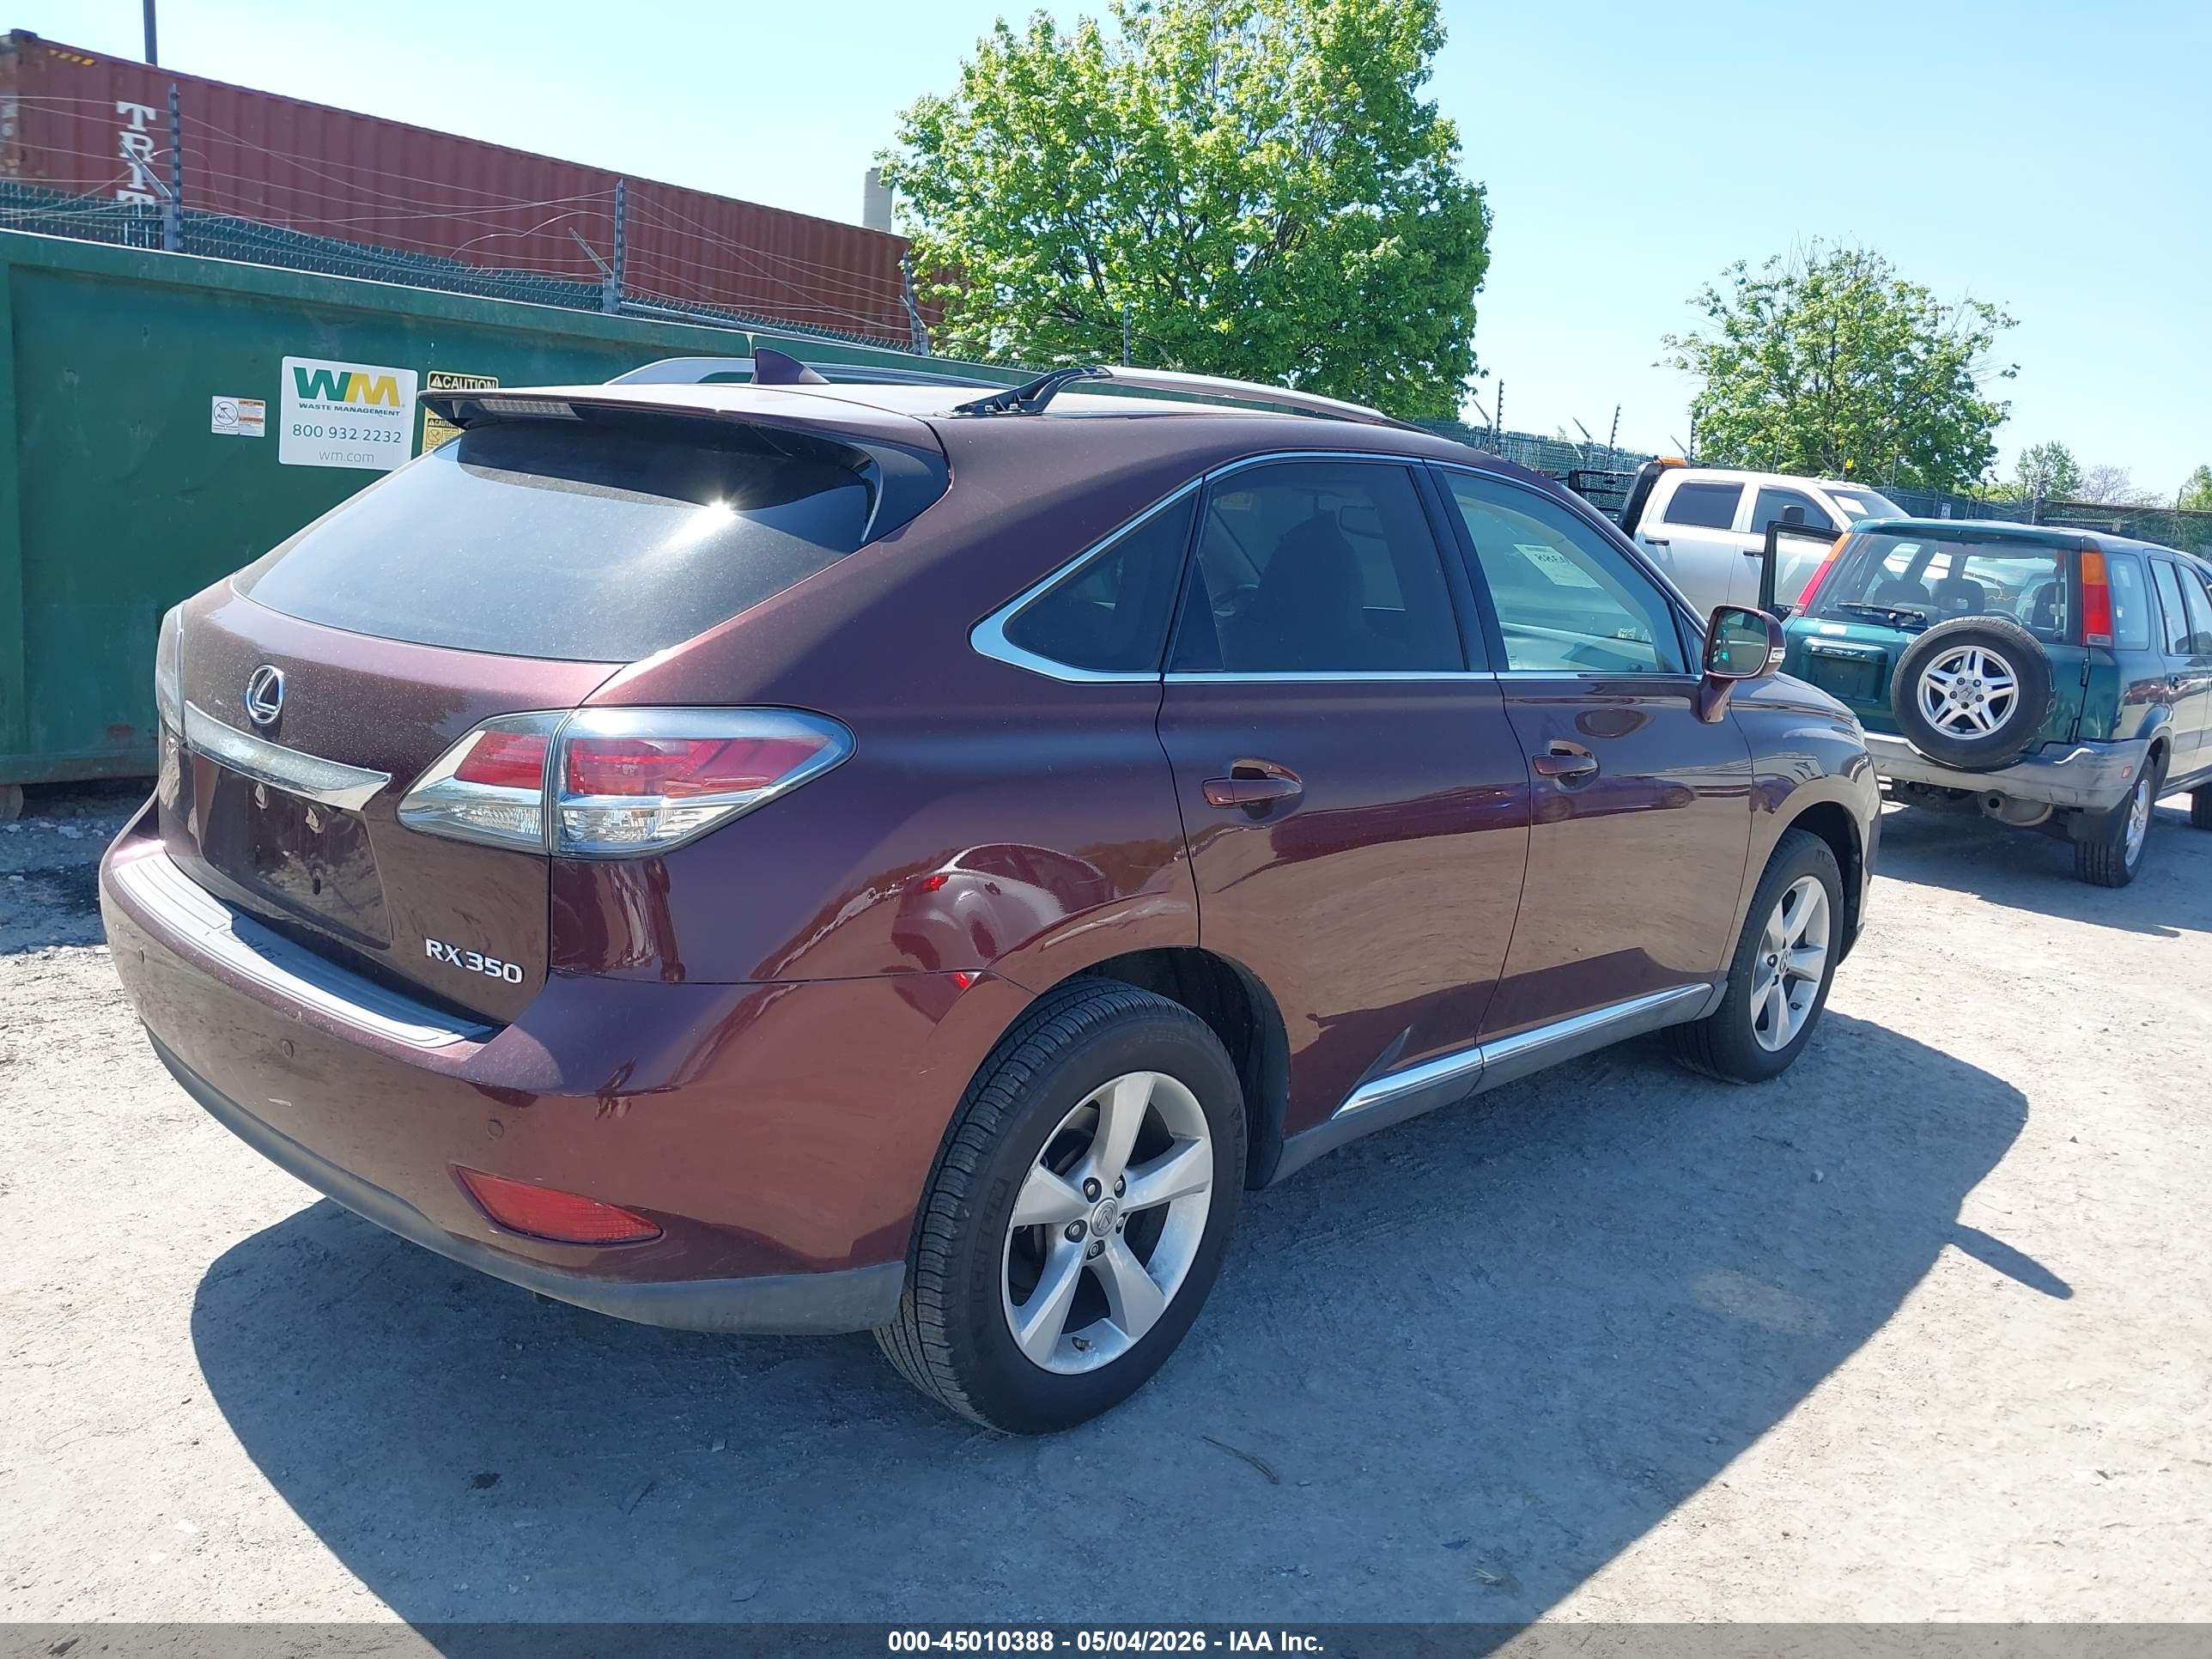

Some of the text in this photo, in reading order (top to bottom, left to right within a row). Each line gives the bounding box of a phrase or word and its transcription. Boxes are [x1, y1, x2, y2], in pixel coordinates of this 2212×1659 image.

[293, 367, 400, 407] WM
[442, 375, 495, 390] CAUTION
[299, 403, 401, 416] WASTE MANAGEMENT
[293, 424, 402, 443] 800 932 2232
[319, 451, 375, 464] wm.com
